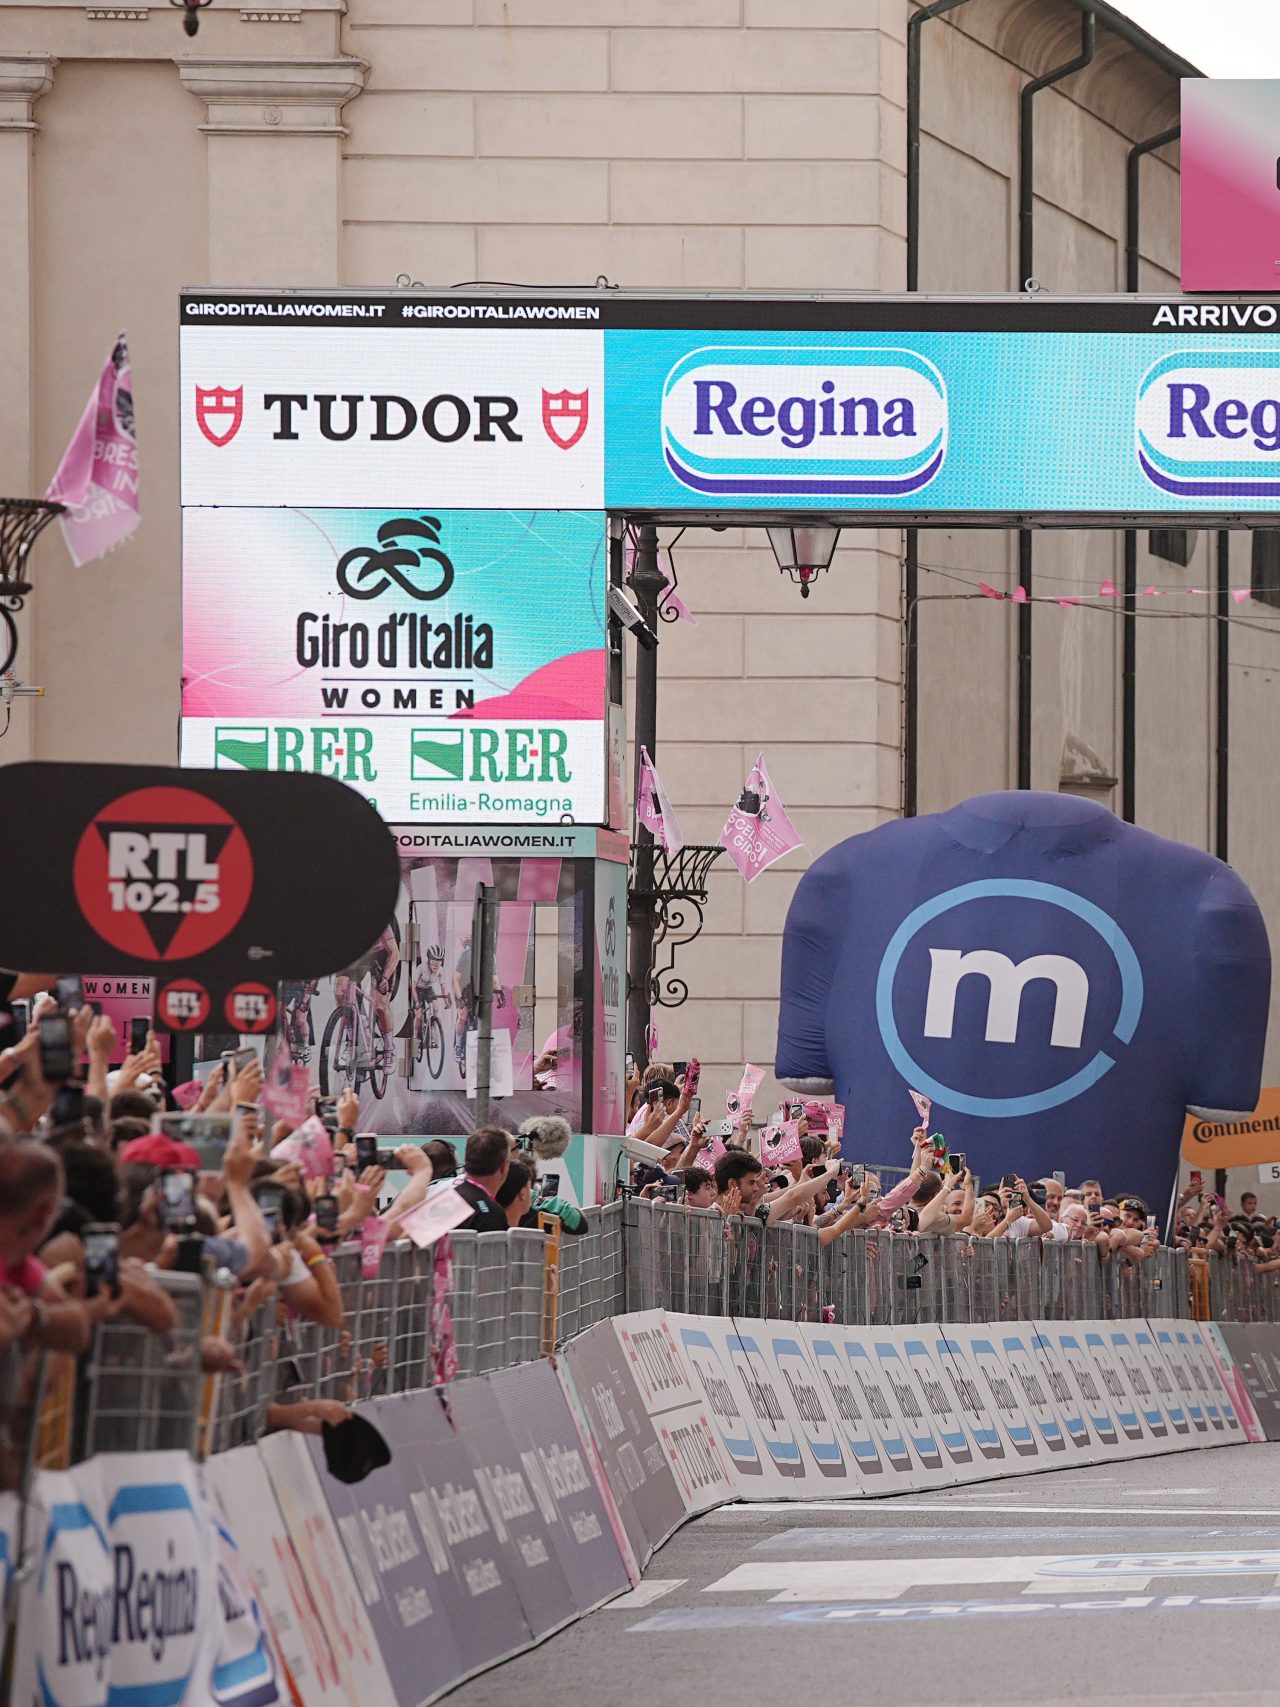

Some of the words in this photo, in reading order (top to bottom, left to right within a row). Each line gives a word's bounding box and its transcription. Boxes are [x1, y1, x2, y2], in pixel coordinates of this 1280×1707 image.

[185, 303, 386, 319] GIRODITALIAWOMEN.IT
[401, 305, 600, 320] #GIRODITALIAWOMEN
[1152, 305, 1278, 328] ARRIVO
[263, 394, 523, 443] TUDOR
[693, 380, 917, 449] Regina
[297, 612, 369, 668] Giro
[378, 612, 493, 669] d'Italia
[321, 689, 476, 709] WOMEN
[410, 793, 573, 816] Emilia-Romagna
[392, 836, 576, 848] RODITALIAWOMEN.IT
[107, 832, 220, 880] RTL
[107, 882, 221, 914] 102.5
[85, 982, 150, 995] WOMEN
[692, 1360, 741, 1429] Regina
[783, 1368, 827, 1433] Regina
